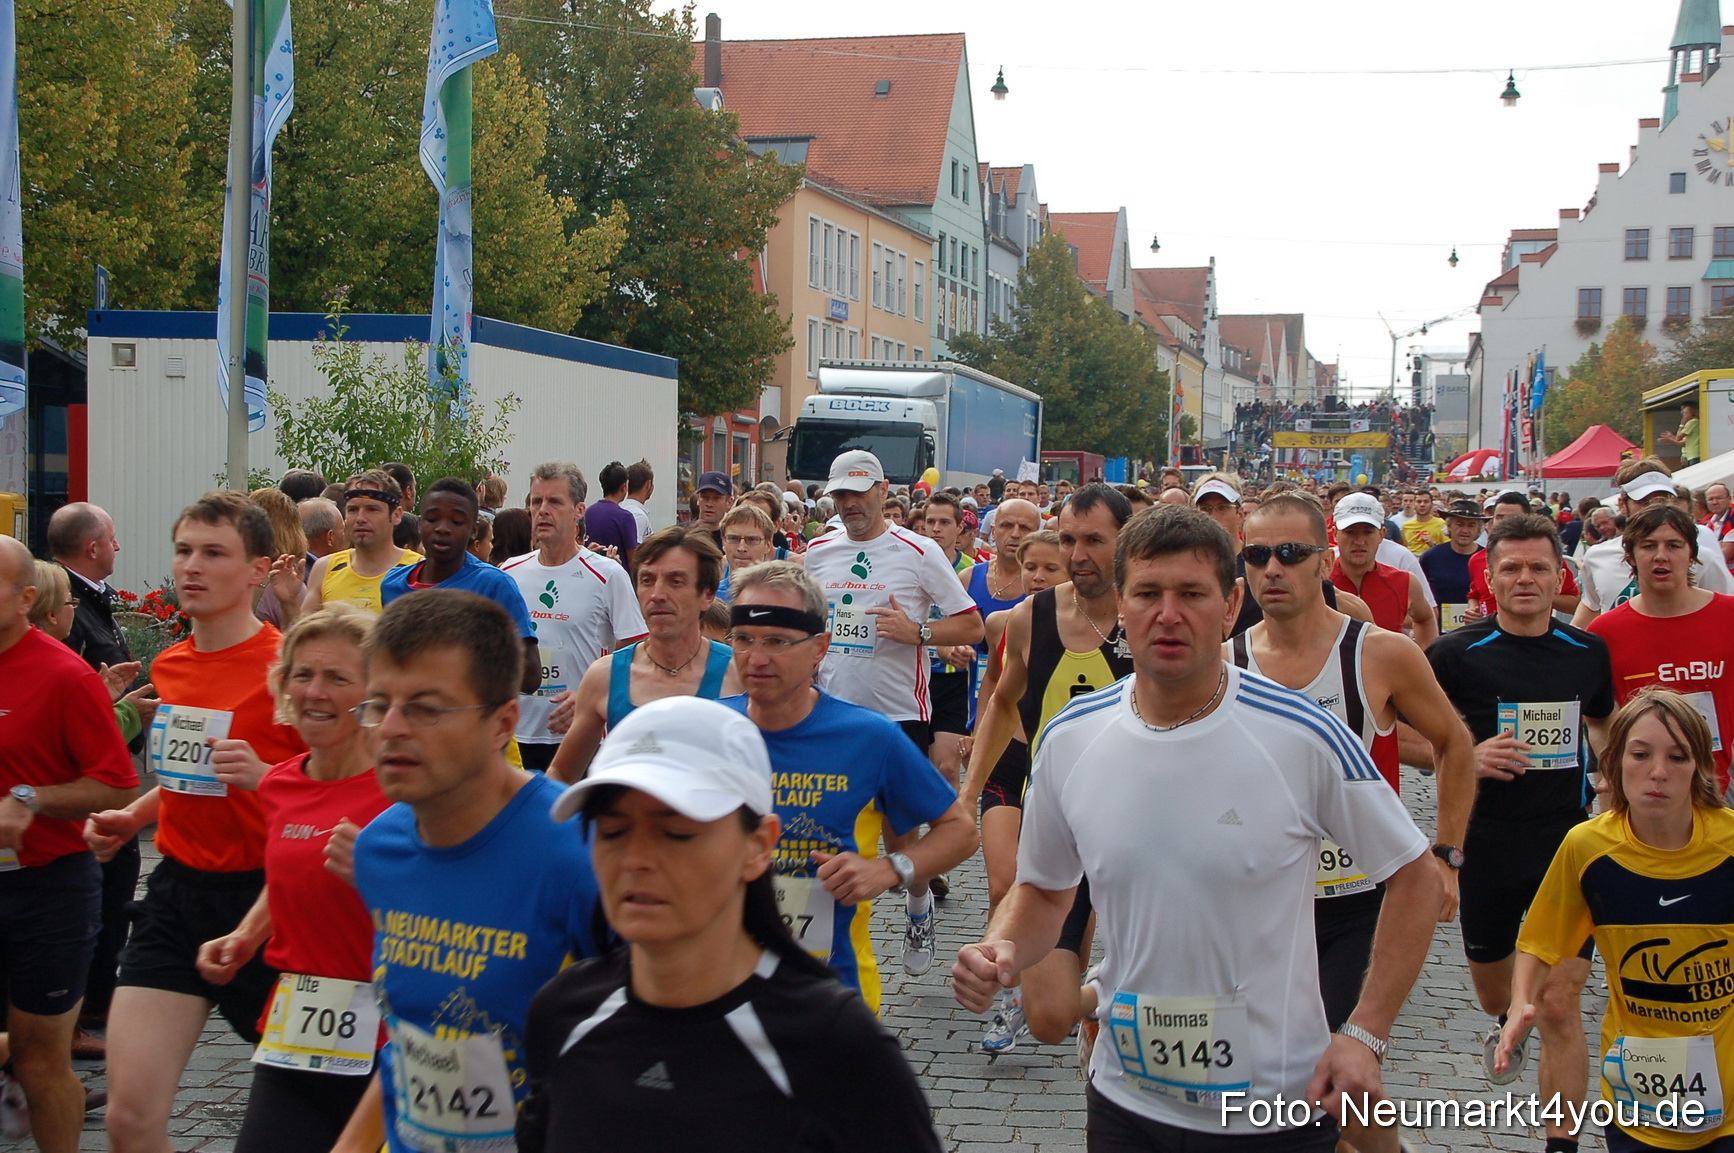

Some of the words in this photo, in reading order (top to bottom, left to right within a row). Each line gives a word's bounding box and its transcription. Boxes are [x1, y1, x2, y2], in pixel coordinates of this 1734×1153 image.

[829, 399, 891, 413] BOCK
[1309, 435, 1349, 445] START
[826, 581, 886, 591] Laufbox.de
[836, 608, 855, 619] Hans-
[836, 623, 869, 639] 3543
[1658, 660, 1725, 682] EnBW
[1523, 708, 1561, 721] Michael
[1524, 728, 1572, 746] 2628
[167, 738, 214, 766] 2207
[281, 823, 316, 840] RUN
[1317, 848, 1353, 871] 98
[386, 909, 528, 961] NEUMARKTER
[379, 936, 489, 981] STADTLAUF
[1683, 957, 1731, 982] FÜRTH
[1688, 976, 1734, 1002] 1860
[301, 1006, 357, 1039] 708
[1143, 1006, 1209, 1028] Thomas
[1150, 1038, 1233, 1069] 3143
[1623, 1049, 1667, 1063] Dominik
[1633, 1072, 1708, 1098] 3844
[410, 1075, 499, 1118] 2142
